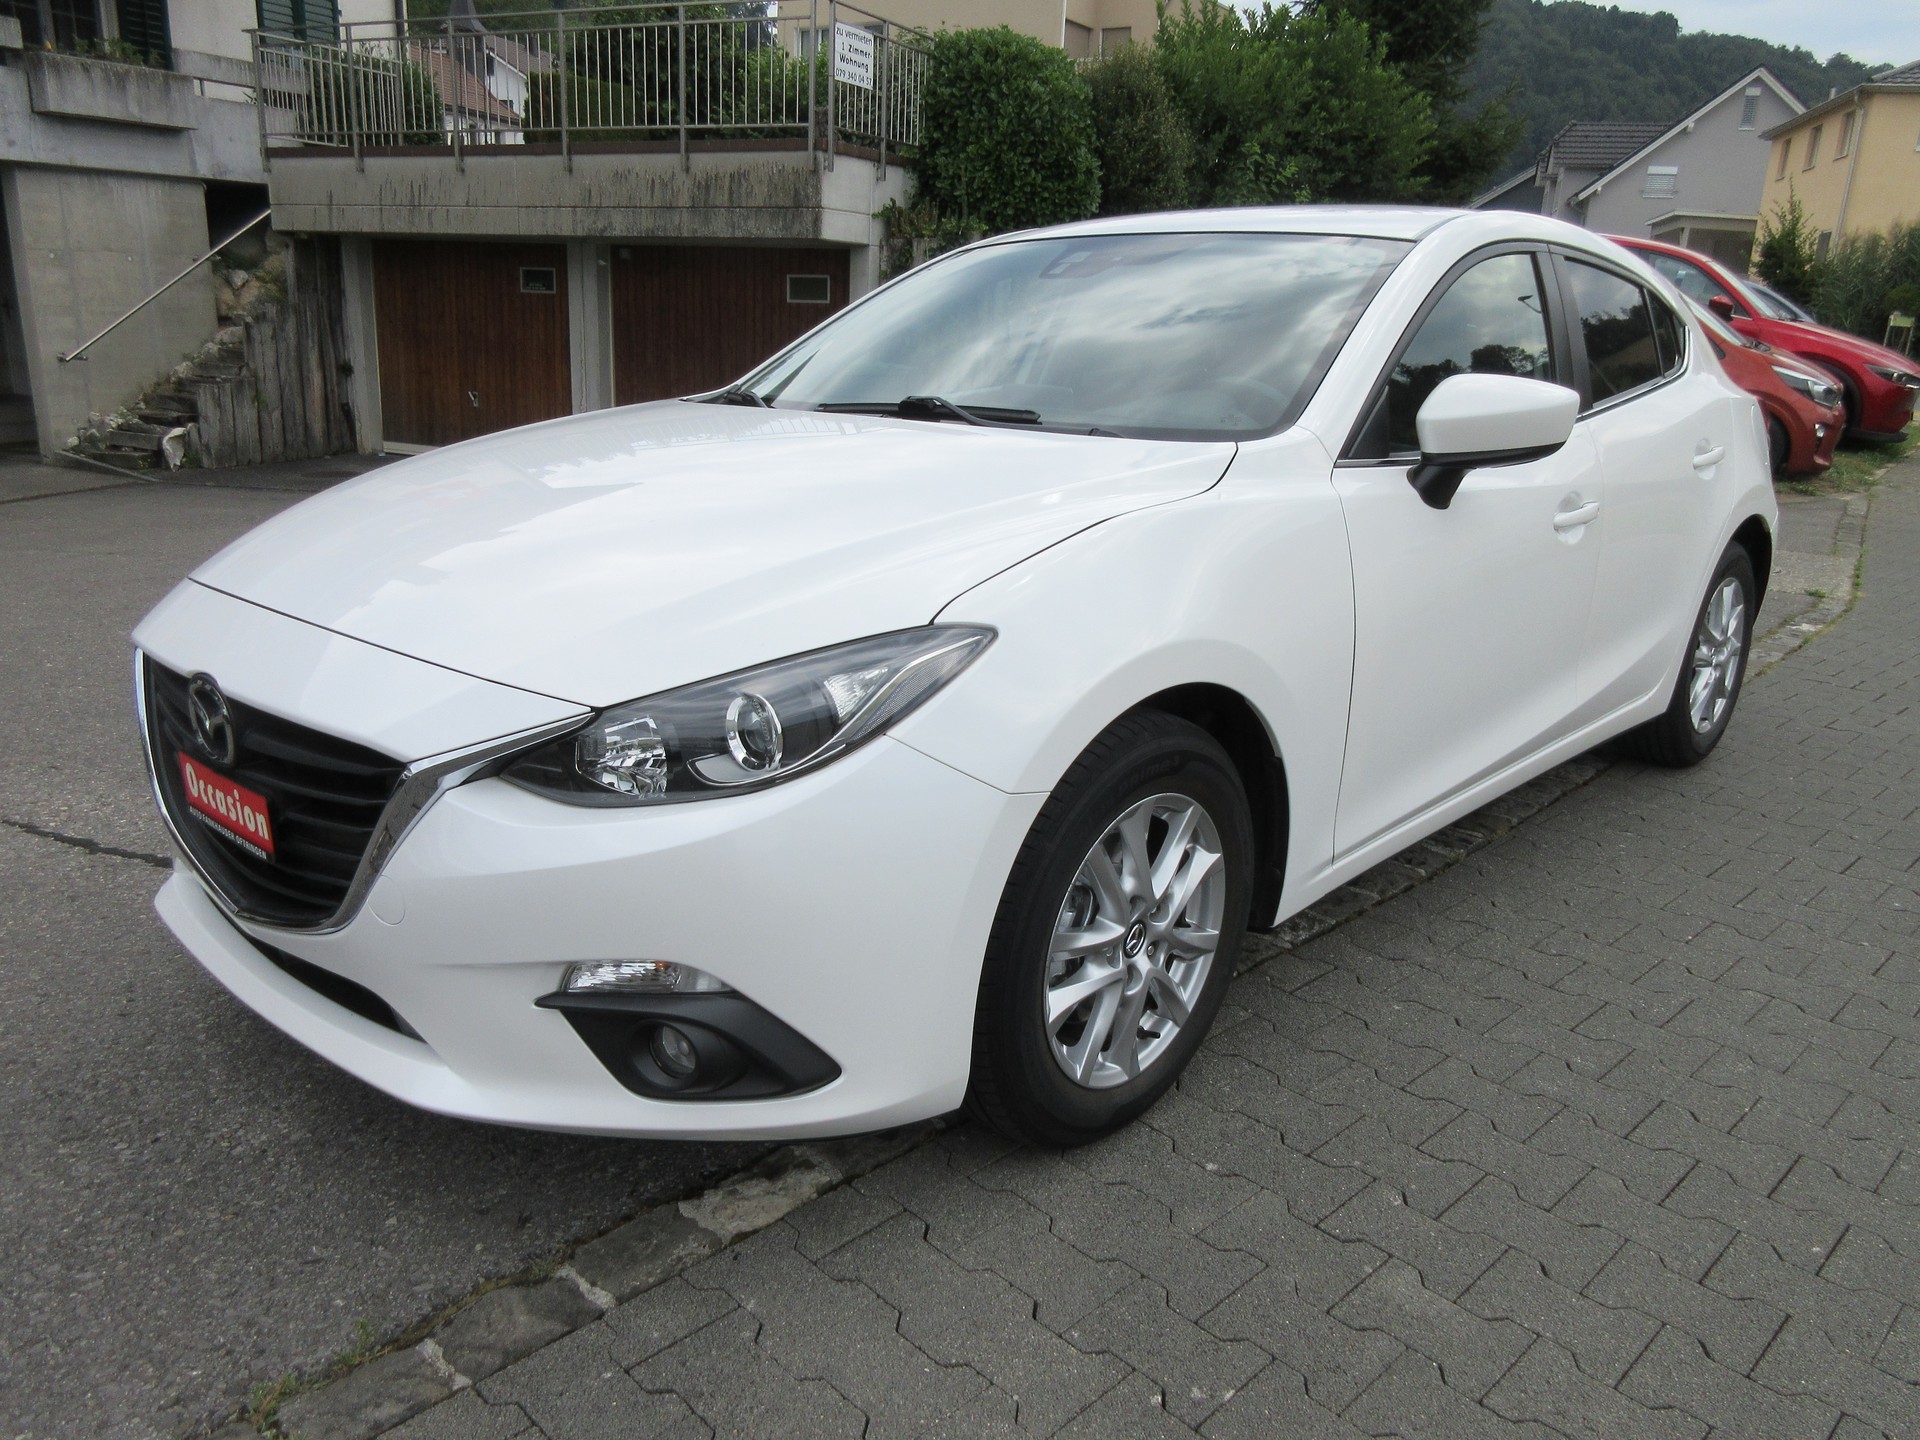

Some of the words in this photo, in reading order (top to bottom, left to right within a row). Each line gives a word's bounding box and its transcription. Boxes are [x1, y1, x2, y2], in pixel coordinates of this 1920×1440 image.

[845, 30, 873, 47] vermieten
[848, 44, 873, 58] Zimmer-
[839, 53, 869, 73] Wohnung
[835, 67, 846, 78] 079
[847, 71, 857, 82] 340
[858, 74, 865, 84] 04
[185, 762, 270, 841] Occasion
[189, 805, 203, 821] AUTO
[236, 835, 268, 860] OFTRINGEN
